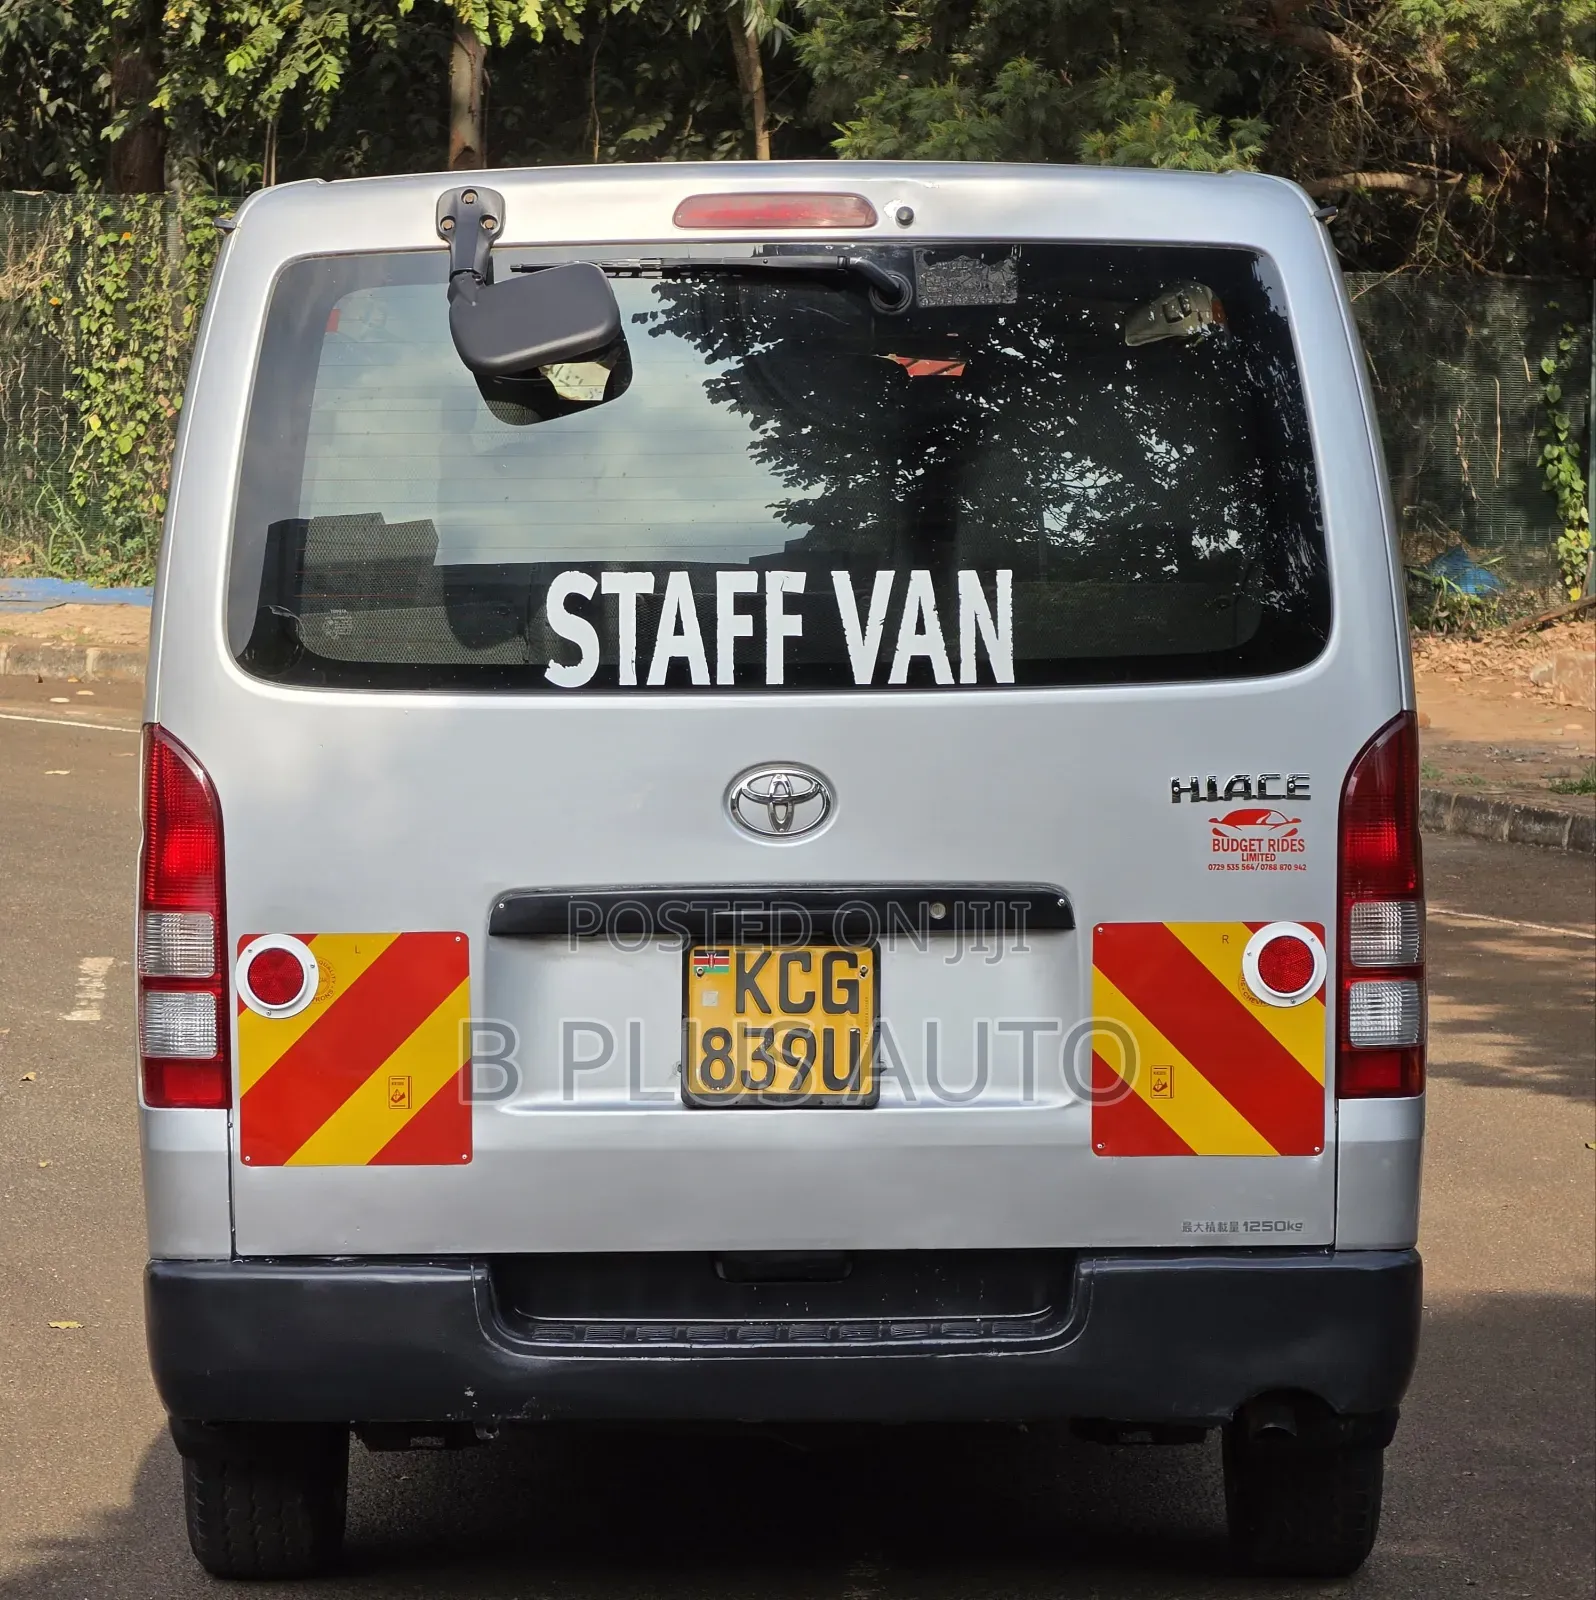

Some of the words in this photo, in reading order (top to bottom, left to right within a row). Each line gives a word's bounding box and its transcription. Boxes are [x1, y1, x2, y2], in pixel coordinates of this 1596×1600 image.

[544, 570, 807, 688] STAFF
[831, 570, 1016, 685] VAN
[1171, 773, 1311, 803] HIACE
[1212, 838, 1264, 852] BUDGET
[1267, 838, 1305, 852] RIDES
[1241, 853, 1276, 862] LIMITED
[1208, 863, 1225, 871] 0729
[1222, 934, 1229, 944] R
[355, 945, 361, 954] L
[735, 950, 860, 1015] KCG
[700, 1027, 861, 1092] 839U
[1181, 1221, 1240, 1233] 最大積載量
[1242, 1220, 1303, 1232] 1250kg
